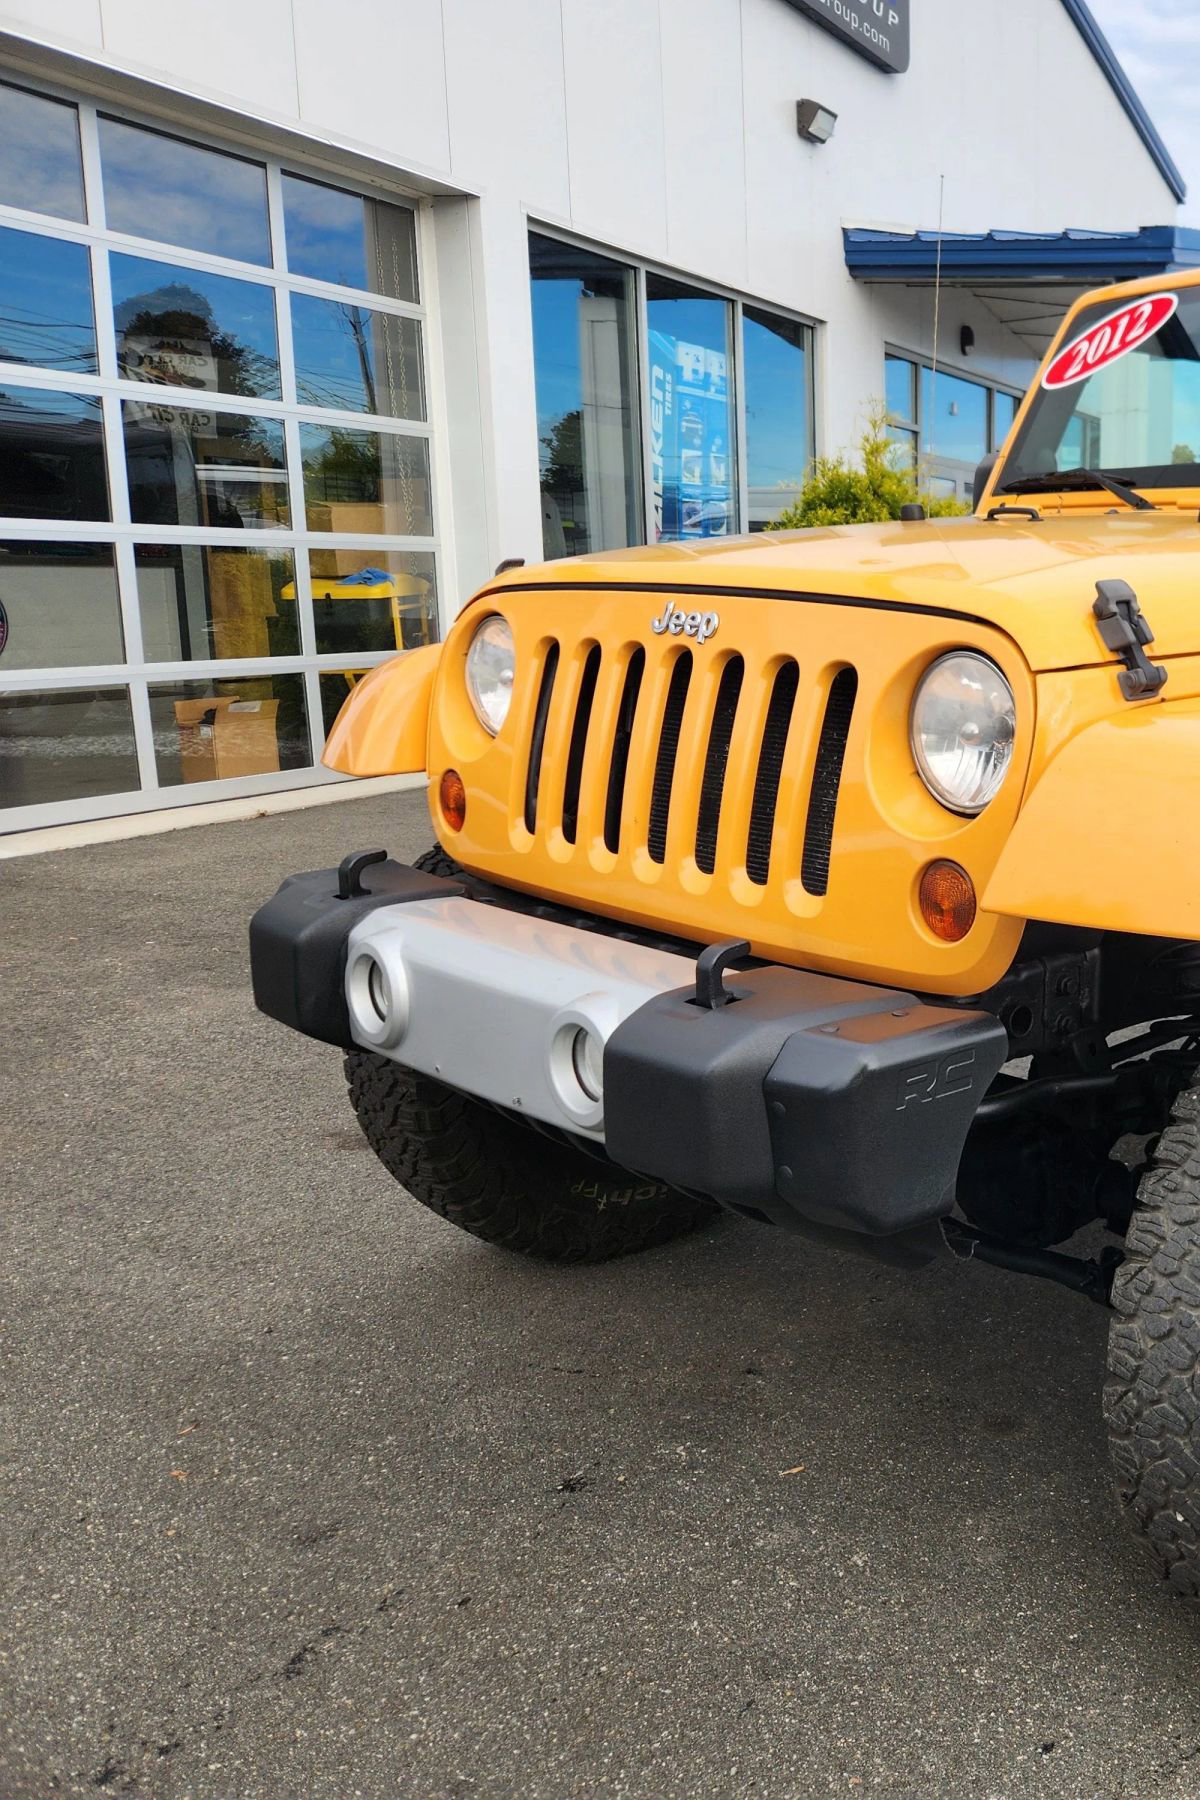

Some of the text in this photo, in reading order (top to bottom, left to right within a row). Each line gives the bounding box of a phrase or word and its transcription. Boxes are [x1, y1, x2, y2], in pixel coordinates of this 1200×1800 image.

[819, 0, 890, 52] roup.com
[1063, 302, 1153, 381] 2012
[664, 372, 672, 416] TIRES
[652, 600, 720, 645] Jeep
